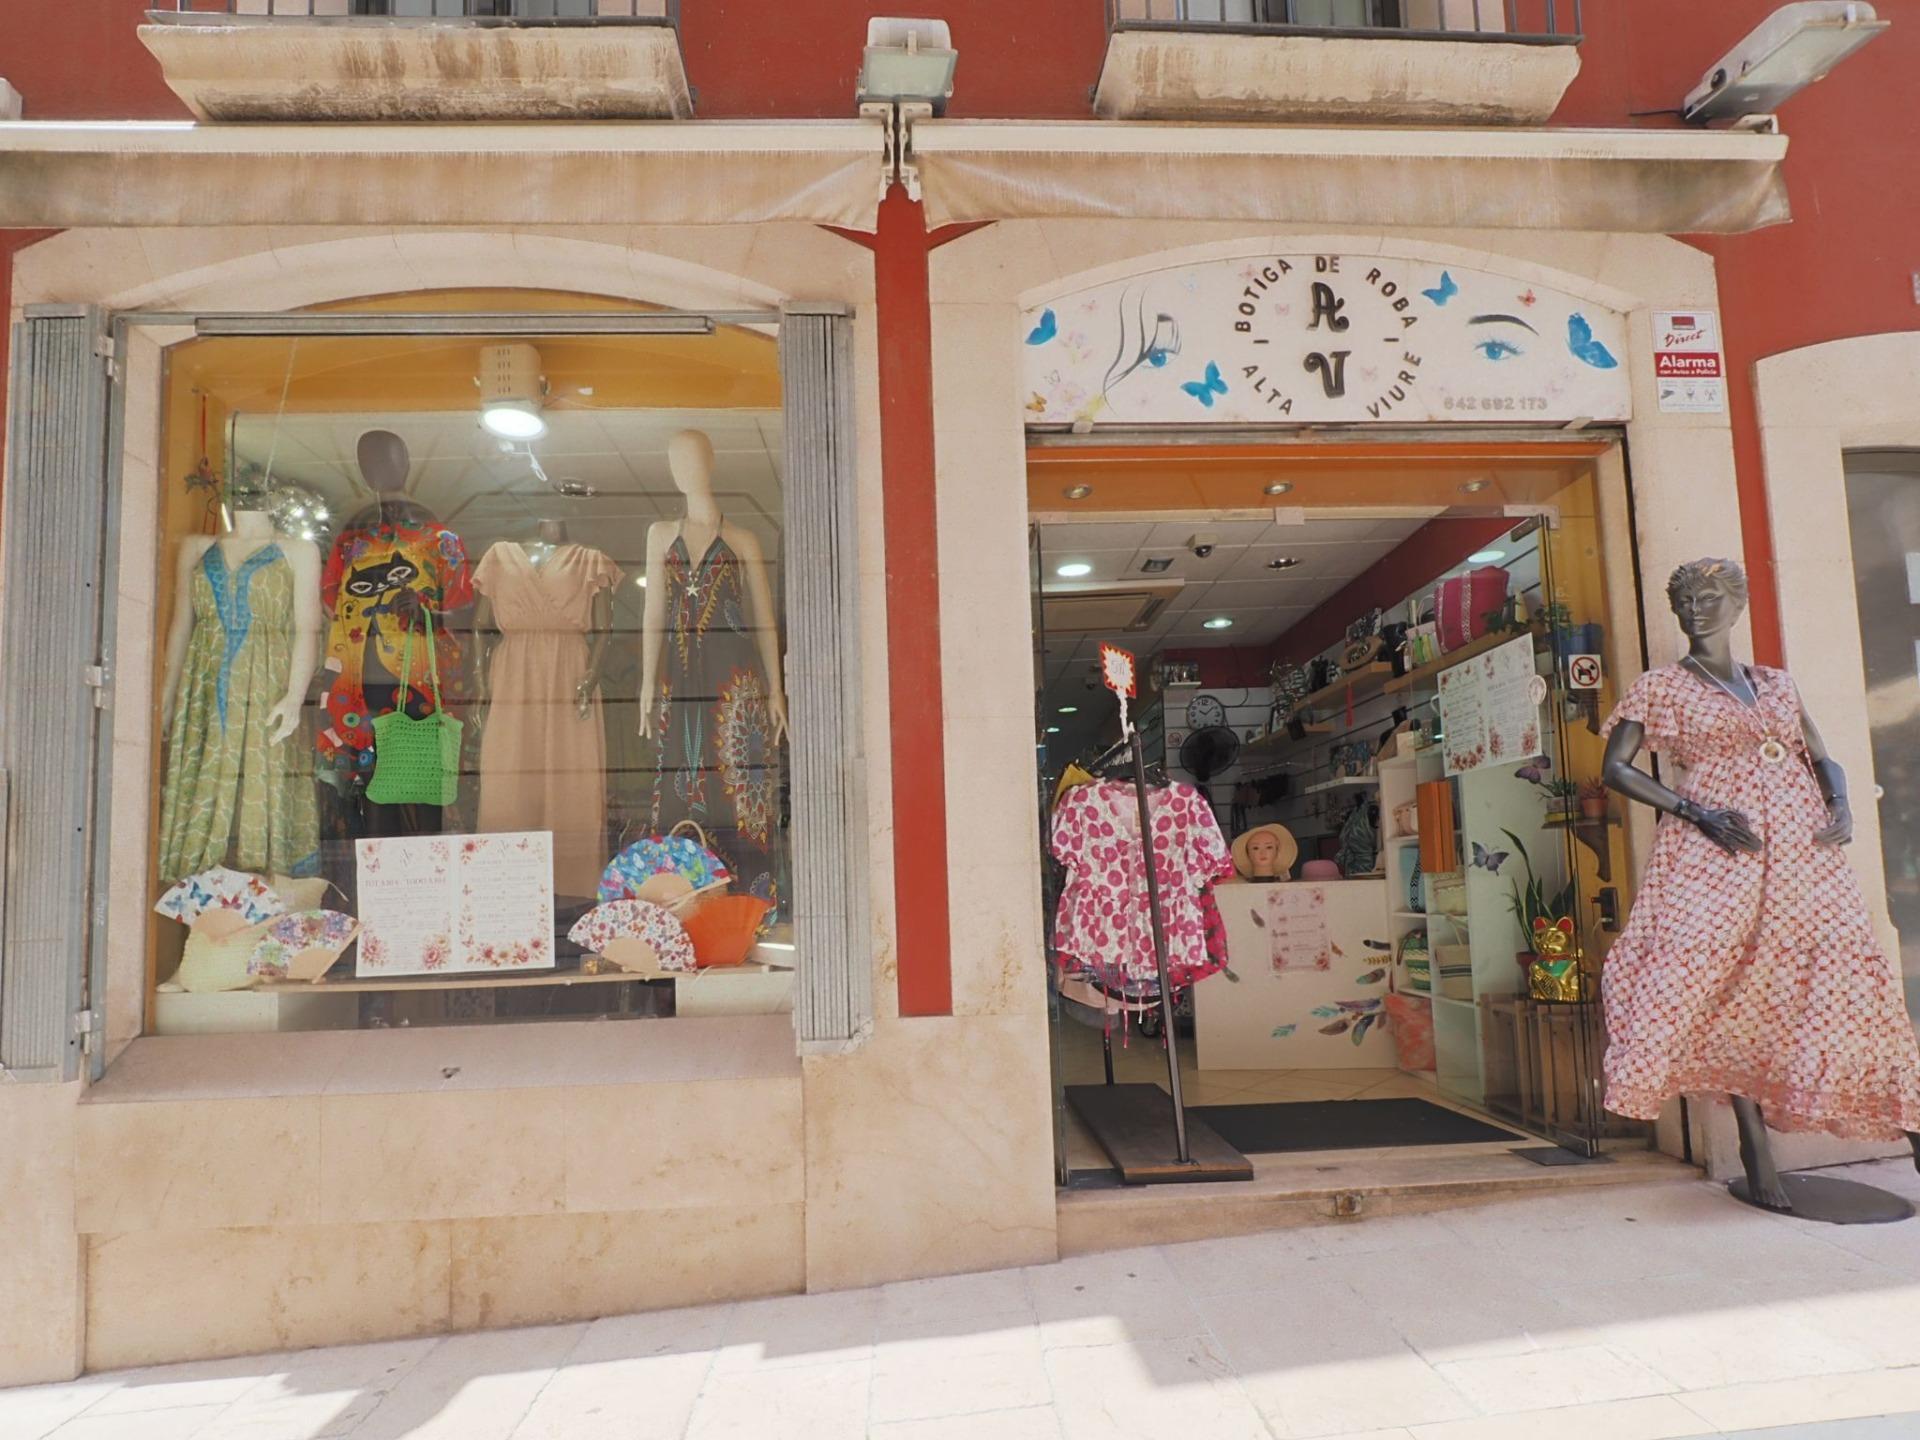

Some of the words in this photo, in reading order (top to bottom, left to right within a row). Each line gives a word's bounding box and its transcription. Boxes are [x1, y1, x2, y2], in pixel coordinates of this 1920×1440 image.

[1235, 259, 1293, 333] BOTIGA
[1315, 256, 1340, 273] DE
[1366, 267, 1418, 328] ROBA
[1242, 364, 1293, 416] ALTA
[1366, 351, 1422, 418] VIURE
[1660, 355, 1716, 368] Alarma
